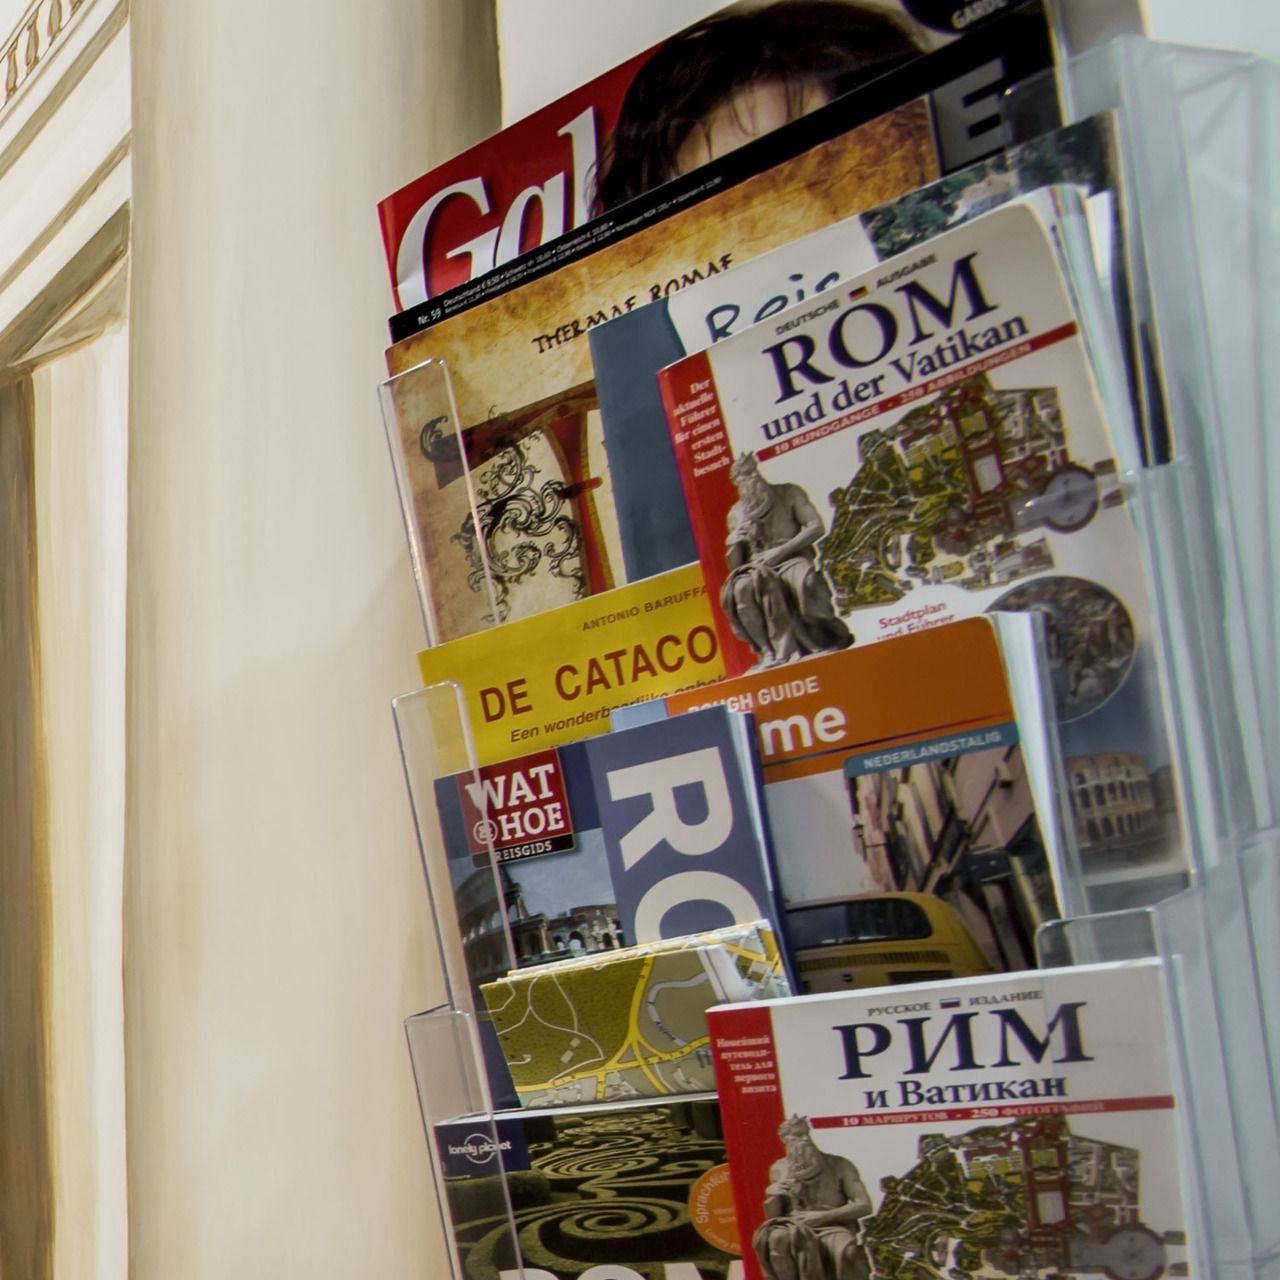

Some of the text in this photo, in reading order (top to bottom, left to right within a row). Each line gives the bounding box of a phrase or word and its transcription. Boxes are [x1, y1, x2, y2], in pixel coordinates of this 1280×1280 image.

[776, 254, 936, 336] DEUTSCHE AUSGABE
[762, 252, 997, 404] ROM
[690, 379, 712, 394] Der
[761, 314, 1028, 441] und der Vatikan
[673, 392, 714, 417] aktuelle
[774, 440, 790, 455] 10
[927, 342, 1032, 396] ABBILDUNGEN
[691, 418, 721, 436] einen
[691, 431, 724, 450] ersten
[693, 456, 730, 478] besuch
[582, 606, 640, 632] ANTONIO
[878, 601, 948, 630] Stadtplan
[480, 625, 718, 723] DE CATACO
[757, 676, 819, 705] GUIDE
[511, 725, 539, 744] Een
[759, 706, 847, 756] me
[864, 731, 1002, 769] NEDERLANDSTALIG
[465, 763, 555, 810] WAT
[498, 802, 565, 841] HOE
[495, 840, 552, 861] REISGIDS
[867, 990, 1042, 1017] РУССКОЕ ИЗДАНИЕ
[833, 1001, 1094, 1081] РИМ
[864, 1076, 1069, 1110] и Ватикан
[842, 1116, 859, 1127] 10
[862, 1111, 948, 1126] МАРШРУТОВ
[971, 1108, 999, 1120] 250
[448, 1141, 512, 1156] lonely planet
